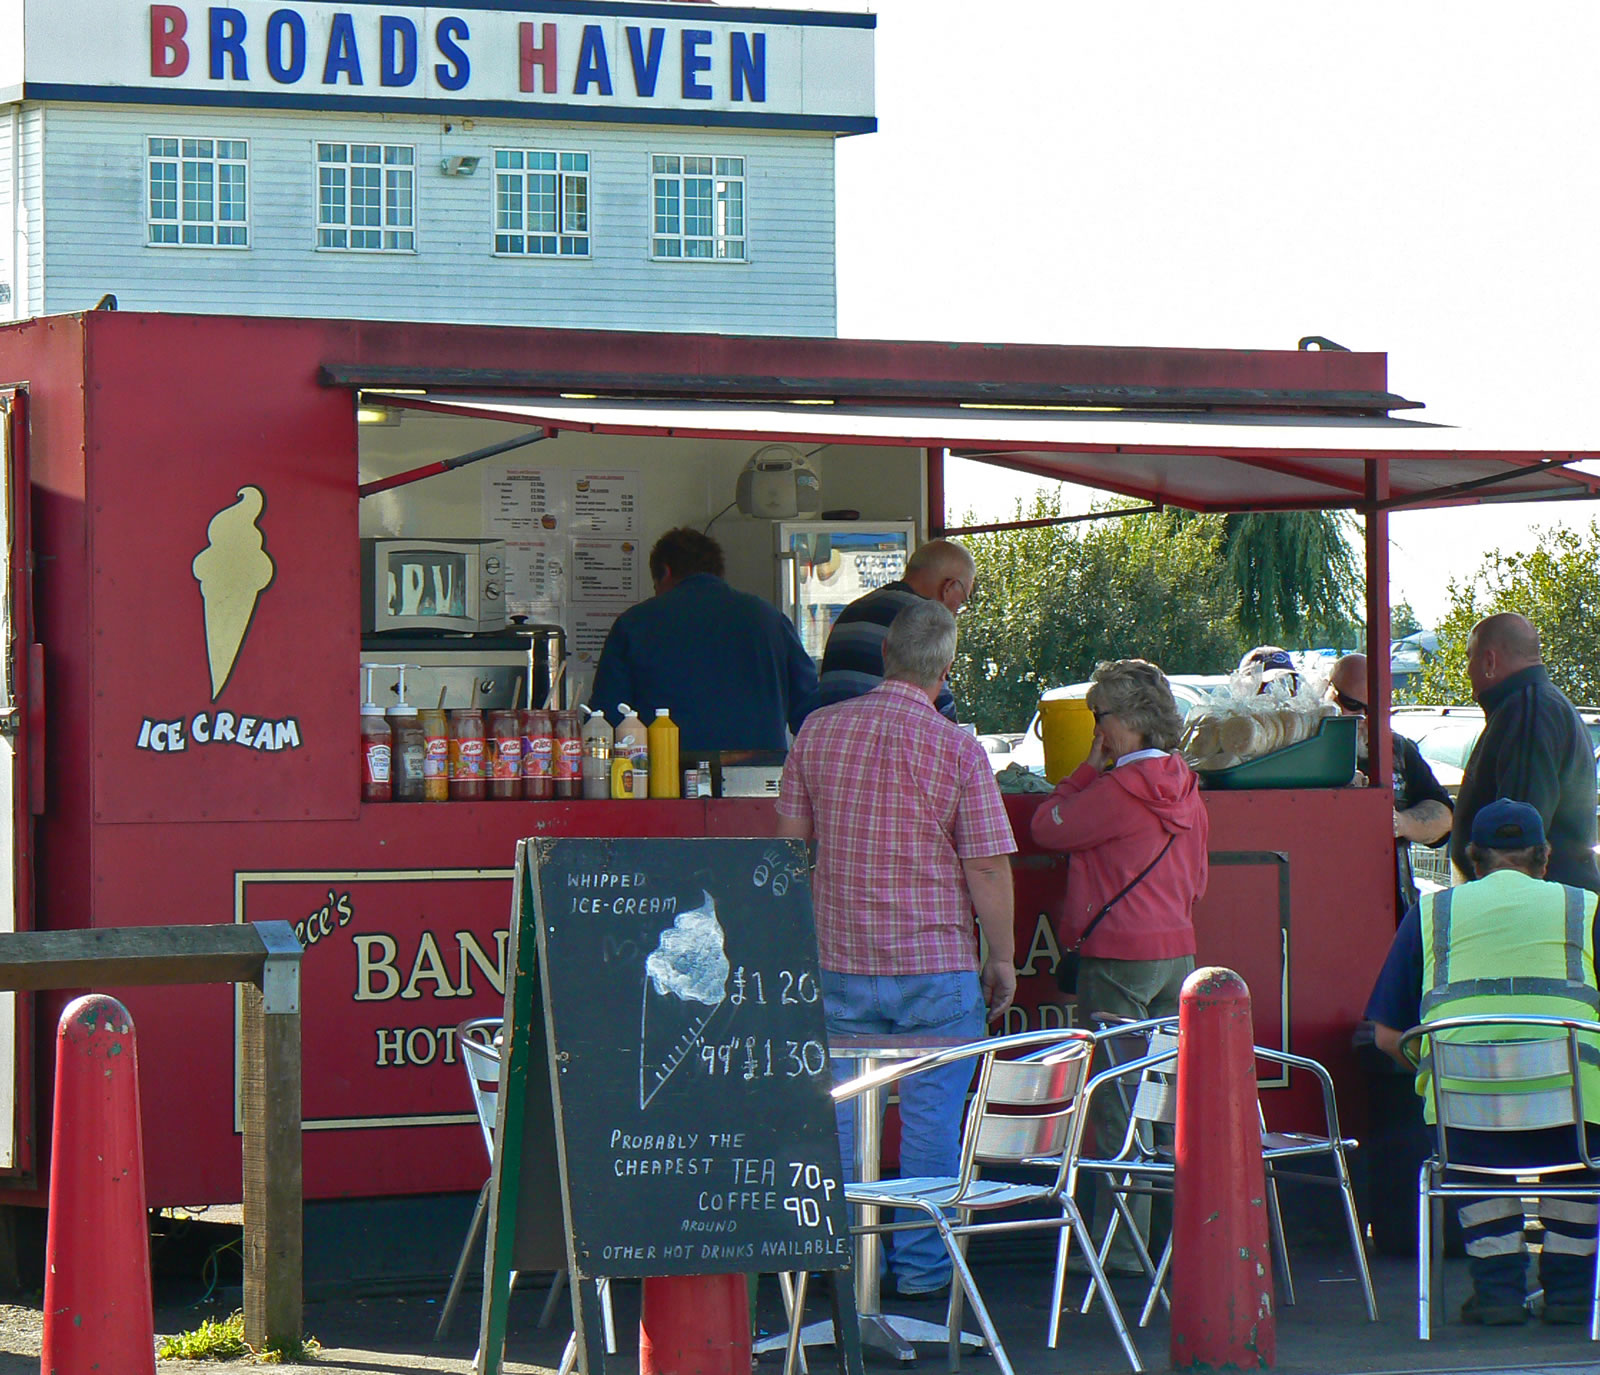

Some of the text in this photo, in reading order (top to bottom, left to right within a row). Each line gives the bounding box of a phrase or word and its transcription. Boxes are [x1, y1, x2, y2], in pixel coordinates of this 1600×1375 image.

[150, 4, 766, 103] BROADS HAVEN
[136, 711, 301, 752] ICE CREAM
[567, 872, 647, 888] WHIPPED
[571, 895, 678, 914] ICE-CREAM
[610, 1128, 746, 1150] PROBABLY THE
[614, 1158, 714, 1177] CHEAPEST
[732, 1158, 775, 1186] TEA
[699, 1191, 777, 1211] COFFEE
[680, 1219, 738, 1233] AROUND
[602, 1245, 657, 1260] OTHER
[663, 1245, 695, 1260] HOT
[701, 1243, 754, 1260] DRINKS
